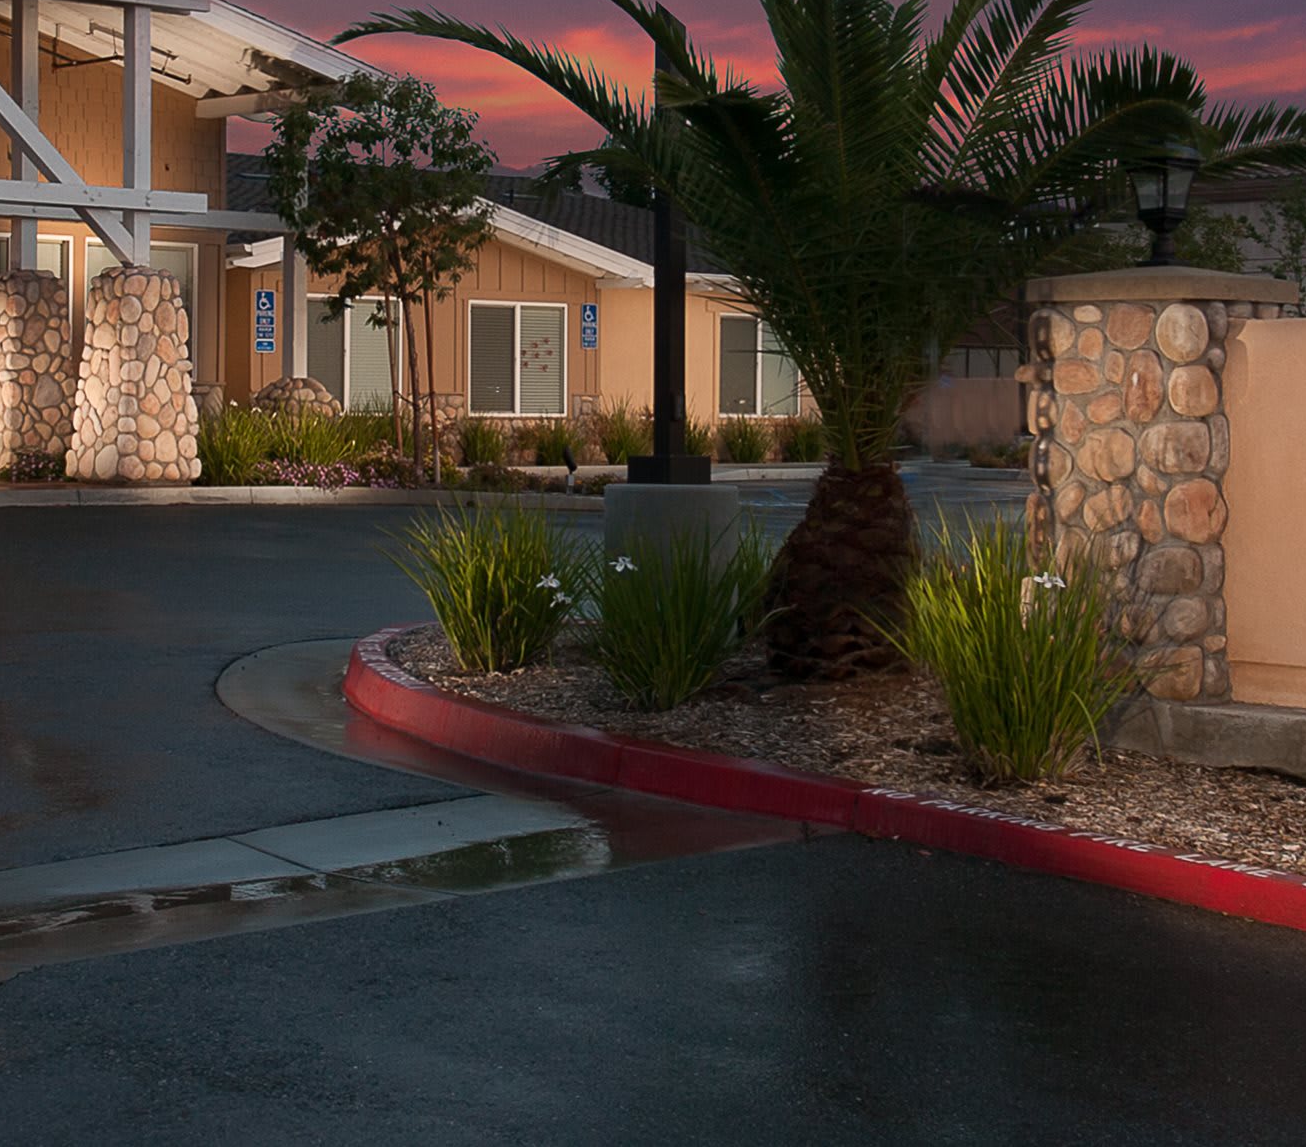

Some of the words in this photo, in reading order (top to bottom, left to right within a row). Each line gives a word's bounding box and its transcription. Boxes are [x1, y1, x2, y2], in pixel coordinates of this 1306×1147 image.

[861, 787, 916, 800] NO
[918, 799, 1066, 832] PARKING
[1068, 831, 1169, 853] FIRE
[1173, 853, 1288, 879] LANE
